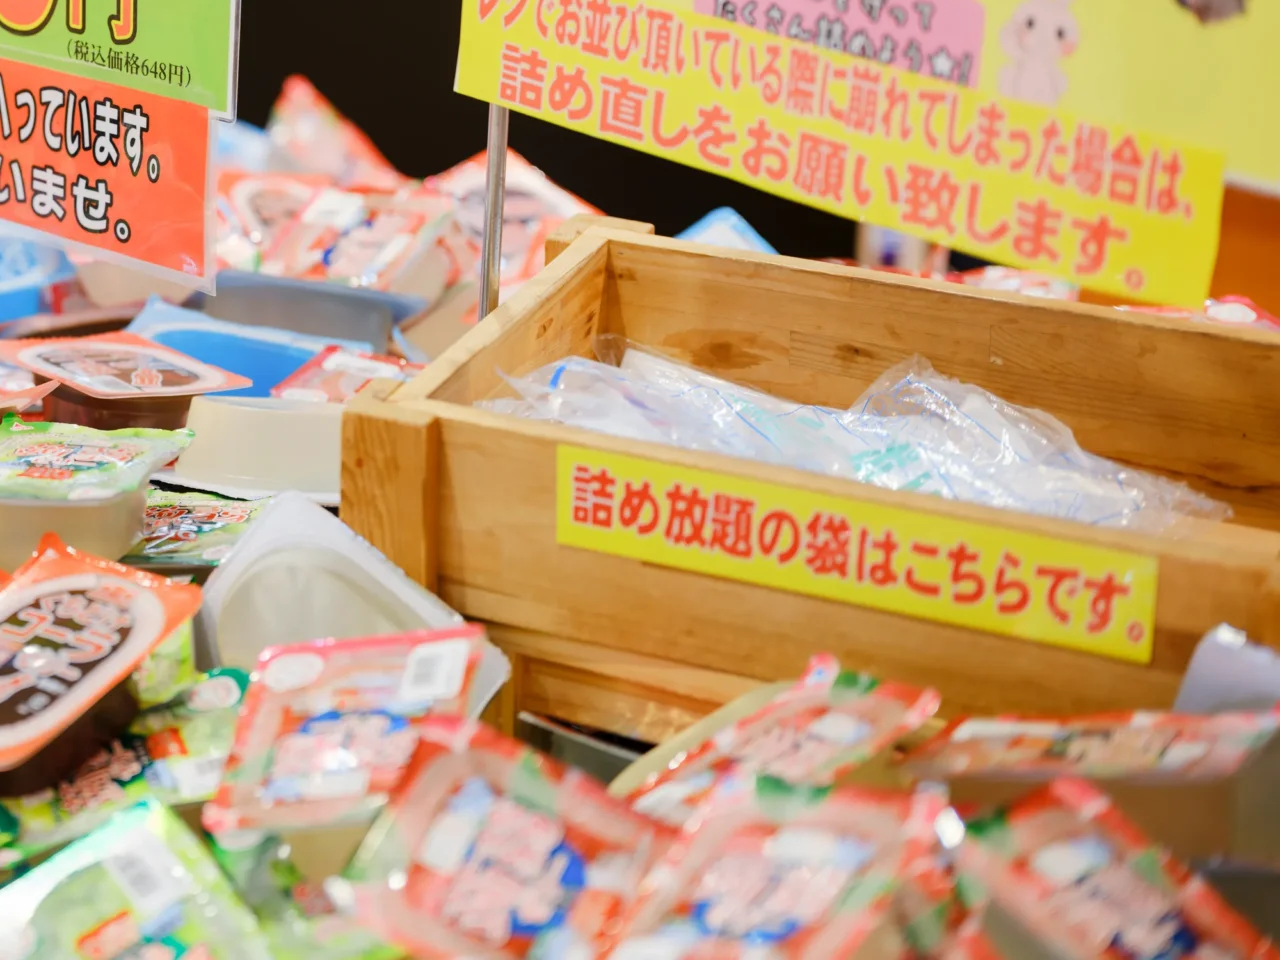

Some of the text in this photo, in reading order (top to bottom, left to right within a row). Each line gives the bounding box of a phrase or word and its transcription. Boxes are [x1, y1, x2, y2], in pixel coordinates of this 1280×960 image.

[499, 43, 1146, 291] 詰め直しをお願い致します。
[572, 464, 1145, 643] 詰め放題の袋はこちらです。
